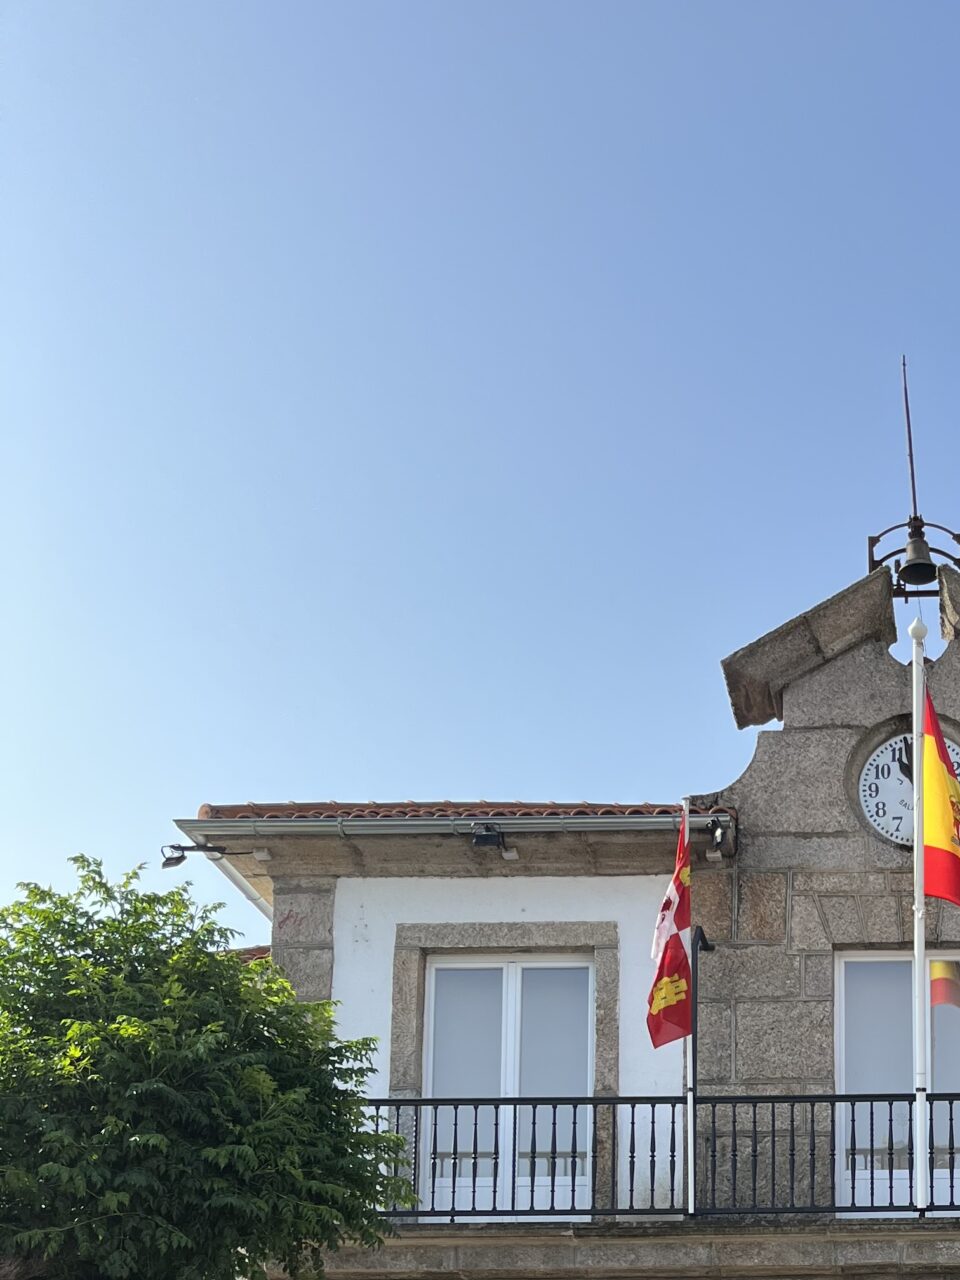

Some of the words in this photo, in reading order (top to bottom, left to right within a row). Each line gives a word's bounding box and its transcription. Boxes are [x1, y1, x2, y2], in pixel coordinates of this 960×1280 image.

[890, 747, 903, 762] 11
[874, 763, 891, 780] 10
[868, 783, 879, 798] 9
[875, 801, 887, 817] 8
[892, 816, 903, 832] 7
